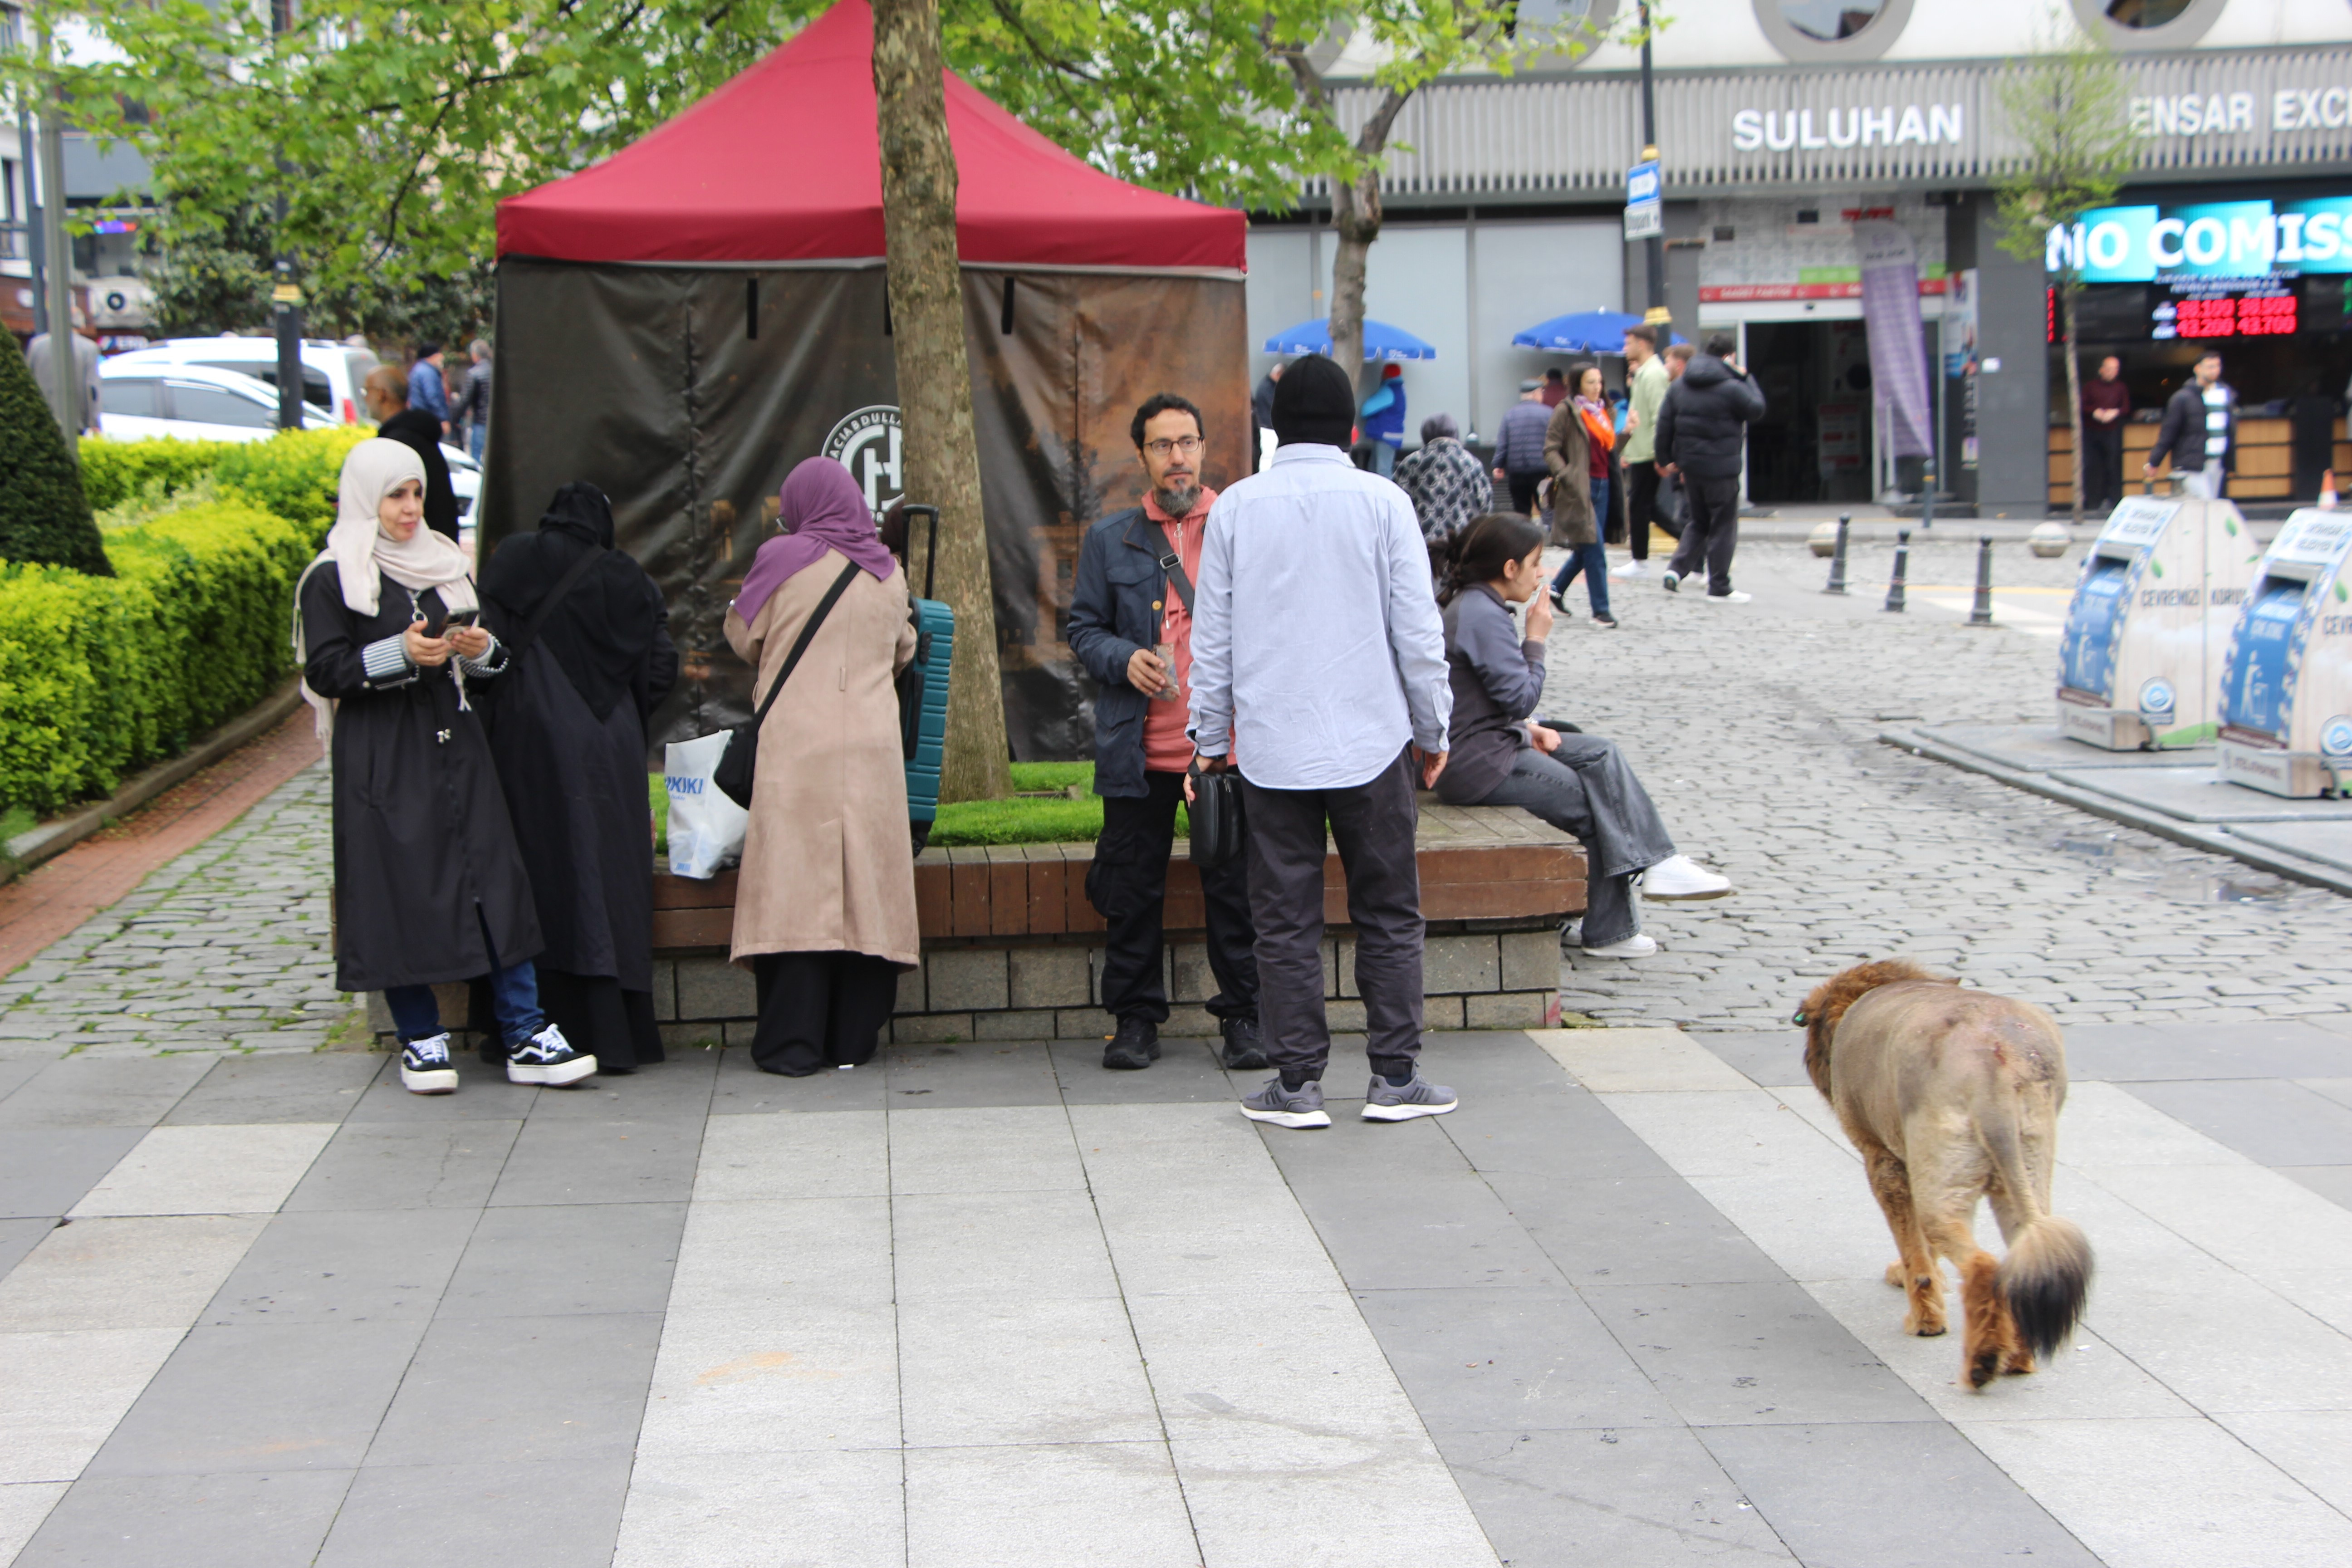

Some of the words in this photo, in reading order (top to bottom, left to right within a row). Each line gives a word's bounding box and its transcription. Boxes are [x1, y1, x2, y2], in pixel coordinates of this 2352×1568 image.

[1732, 103, 1962, 152] SULUHAN
[2129, 92, 2254, 136] ENSAR
[2273, 86, 2352, 131] EXC
[2046, 220, 2129, 271] NO
